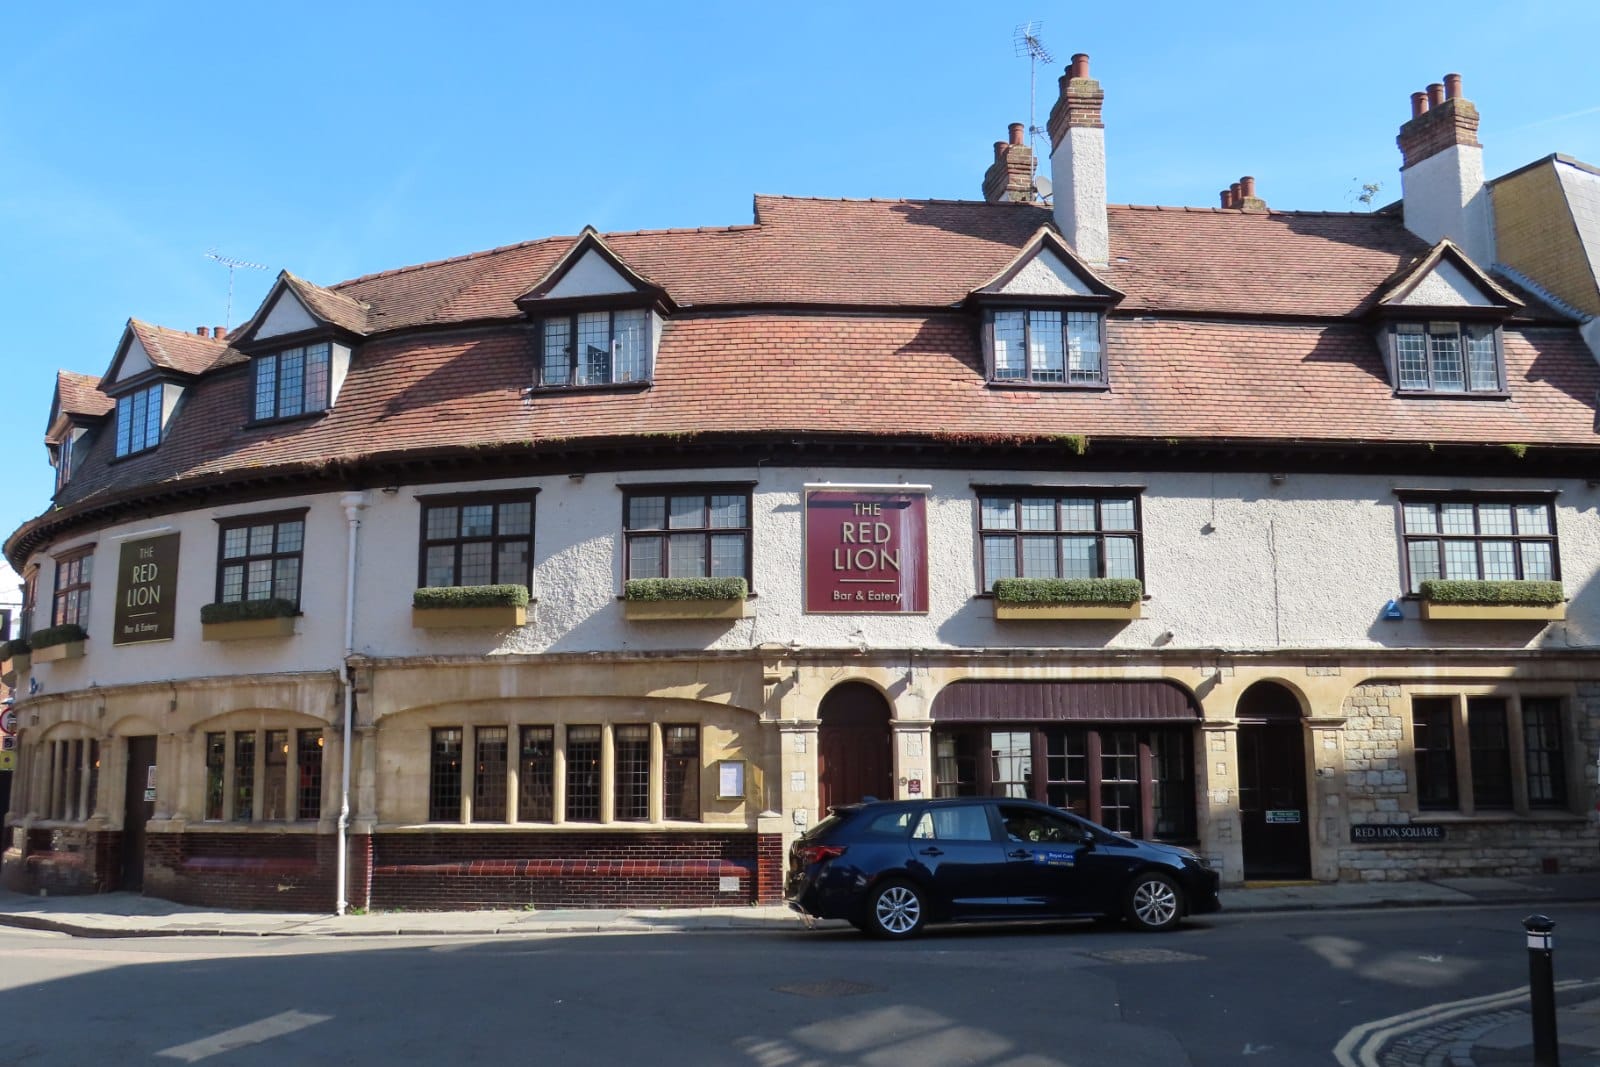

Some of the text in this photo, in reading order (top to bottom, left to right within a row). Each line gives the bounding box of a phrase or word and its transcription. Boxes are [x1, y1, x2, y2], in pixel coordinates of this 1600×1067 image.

[853, 503, 881, 516] THE
[843, 522, 891, 543] RED
[139, 546, 154, 559] THE
[834, 549, 900, 570] LION
[133, 563, 158, 584] RED
[127, 585, 160, 607] LION
[833, 591, 902, 603] Bar & Eatery
[1355, 827, 1439, 837] RED LION SQUARE
